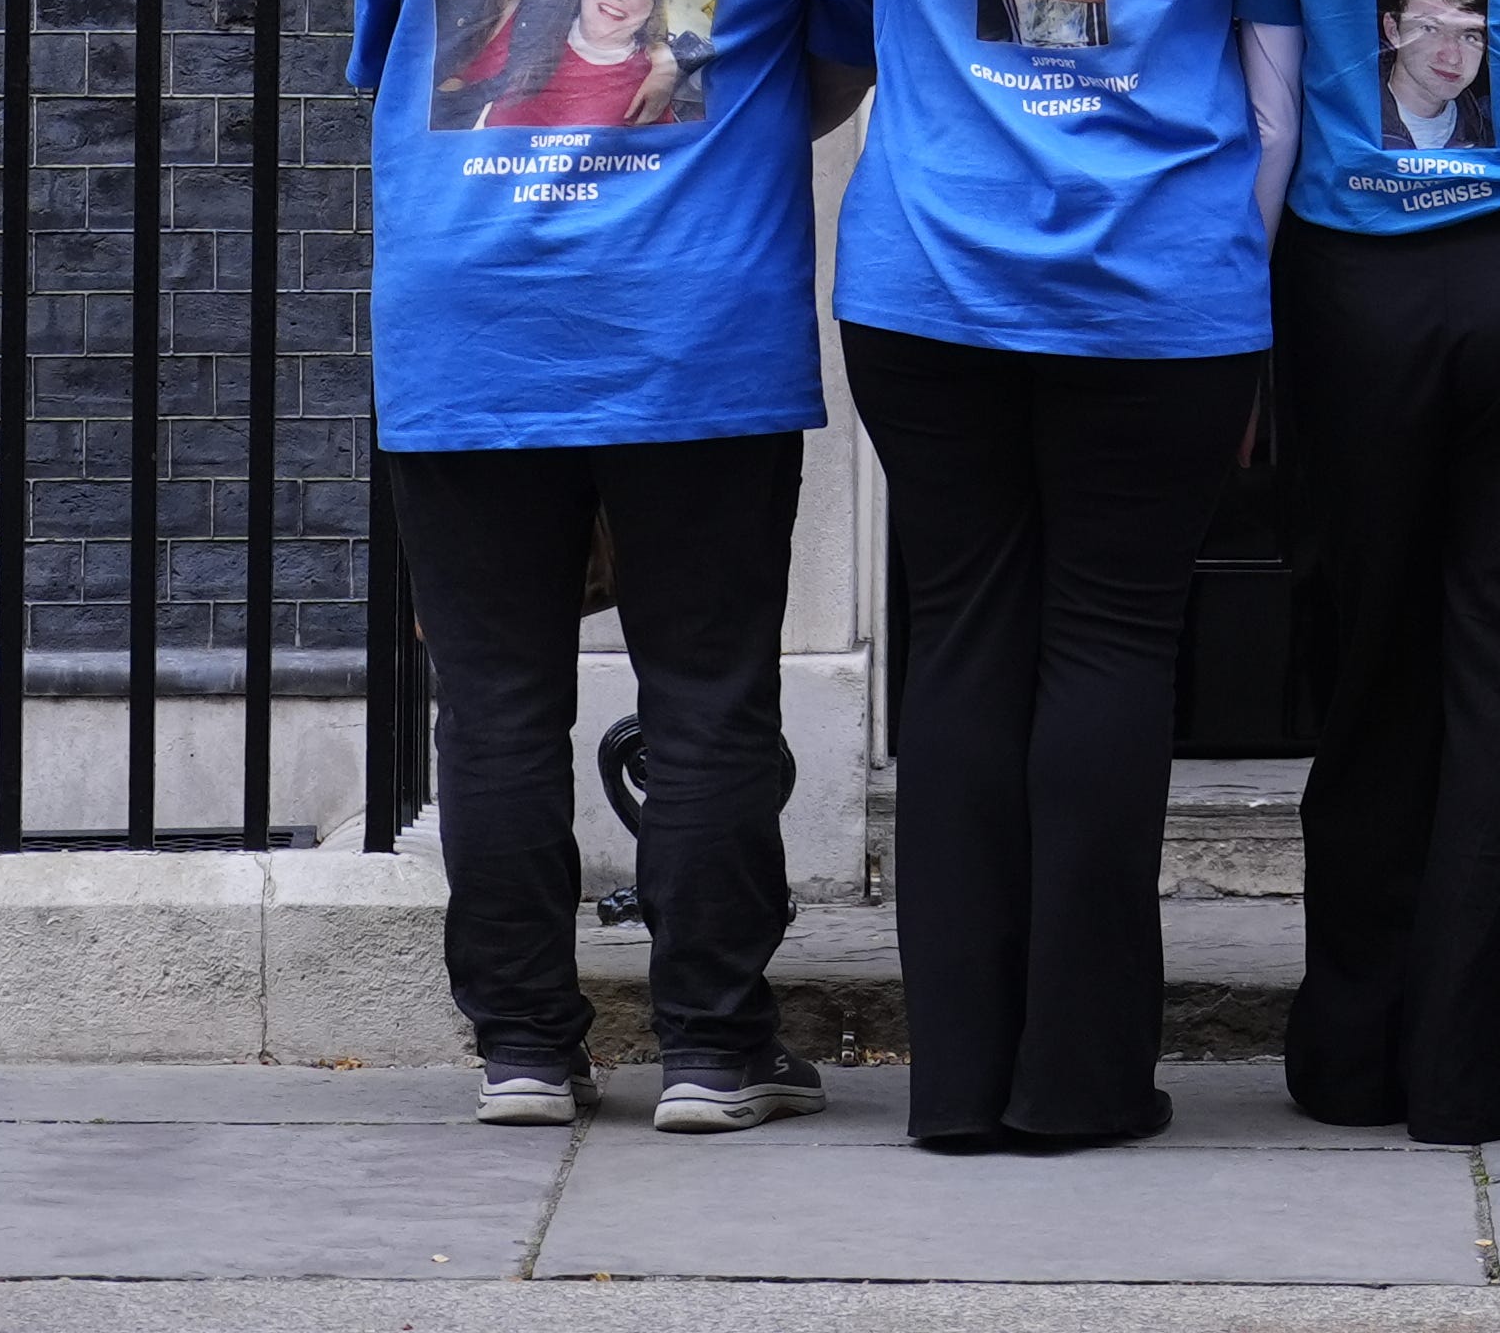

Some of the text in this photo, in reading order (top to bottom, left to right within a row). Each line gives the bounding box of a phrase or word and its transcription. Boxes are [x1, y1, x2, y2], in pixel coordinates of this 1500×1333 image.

[1032, 56, 1076, 69] SUPPORT
[970, 64, 1075, 91] GRADUATED
[1022, 96, 1101, 117] LICENSES
[530, 134, 591, 148] SUPPORT
[463, 154, 660, 176] GRADUATED DRIVING
[1397, 157, 1486, 175] SUPPORT
[513, 183, 599, 203] LICENSES
[1402, 181, 1493, 212] LICENSES
